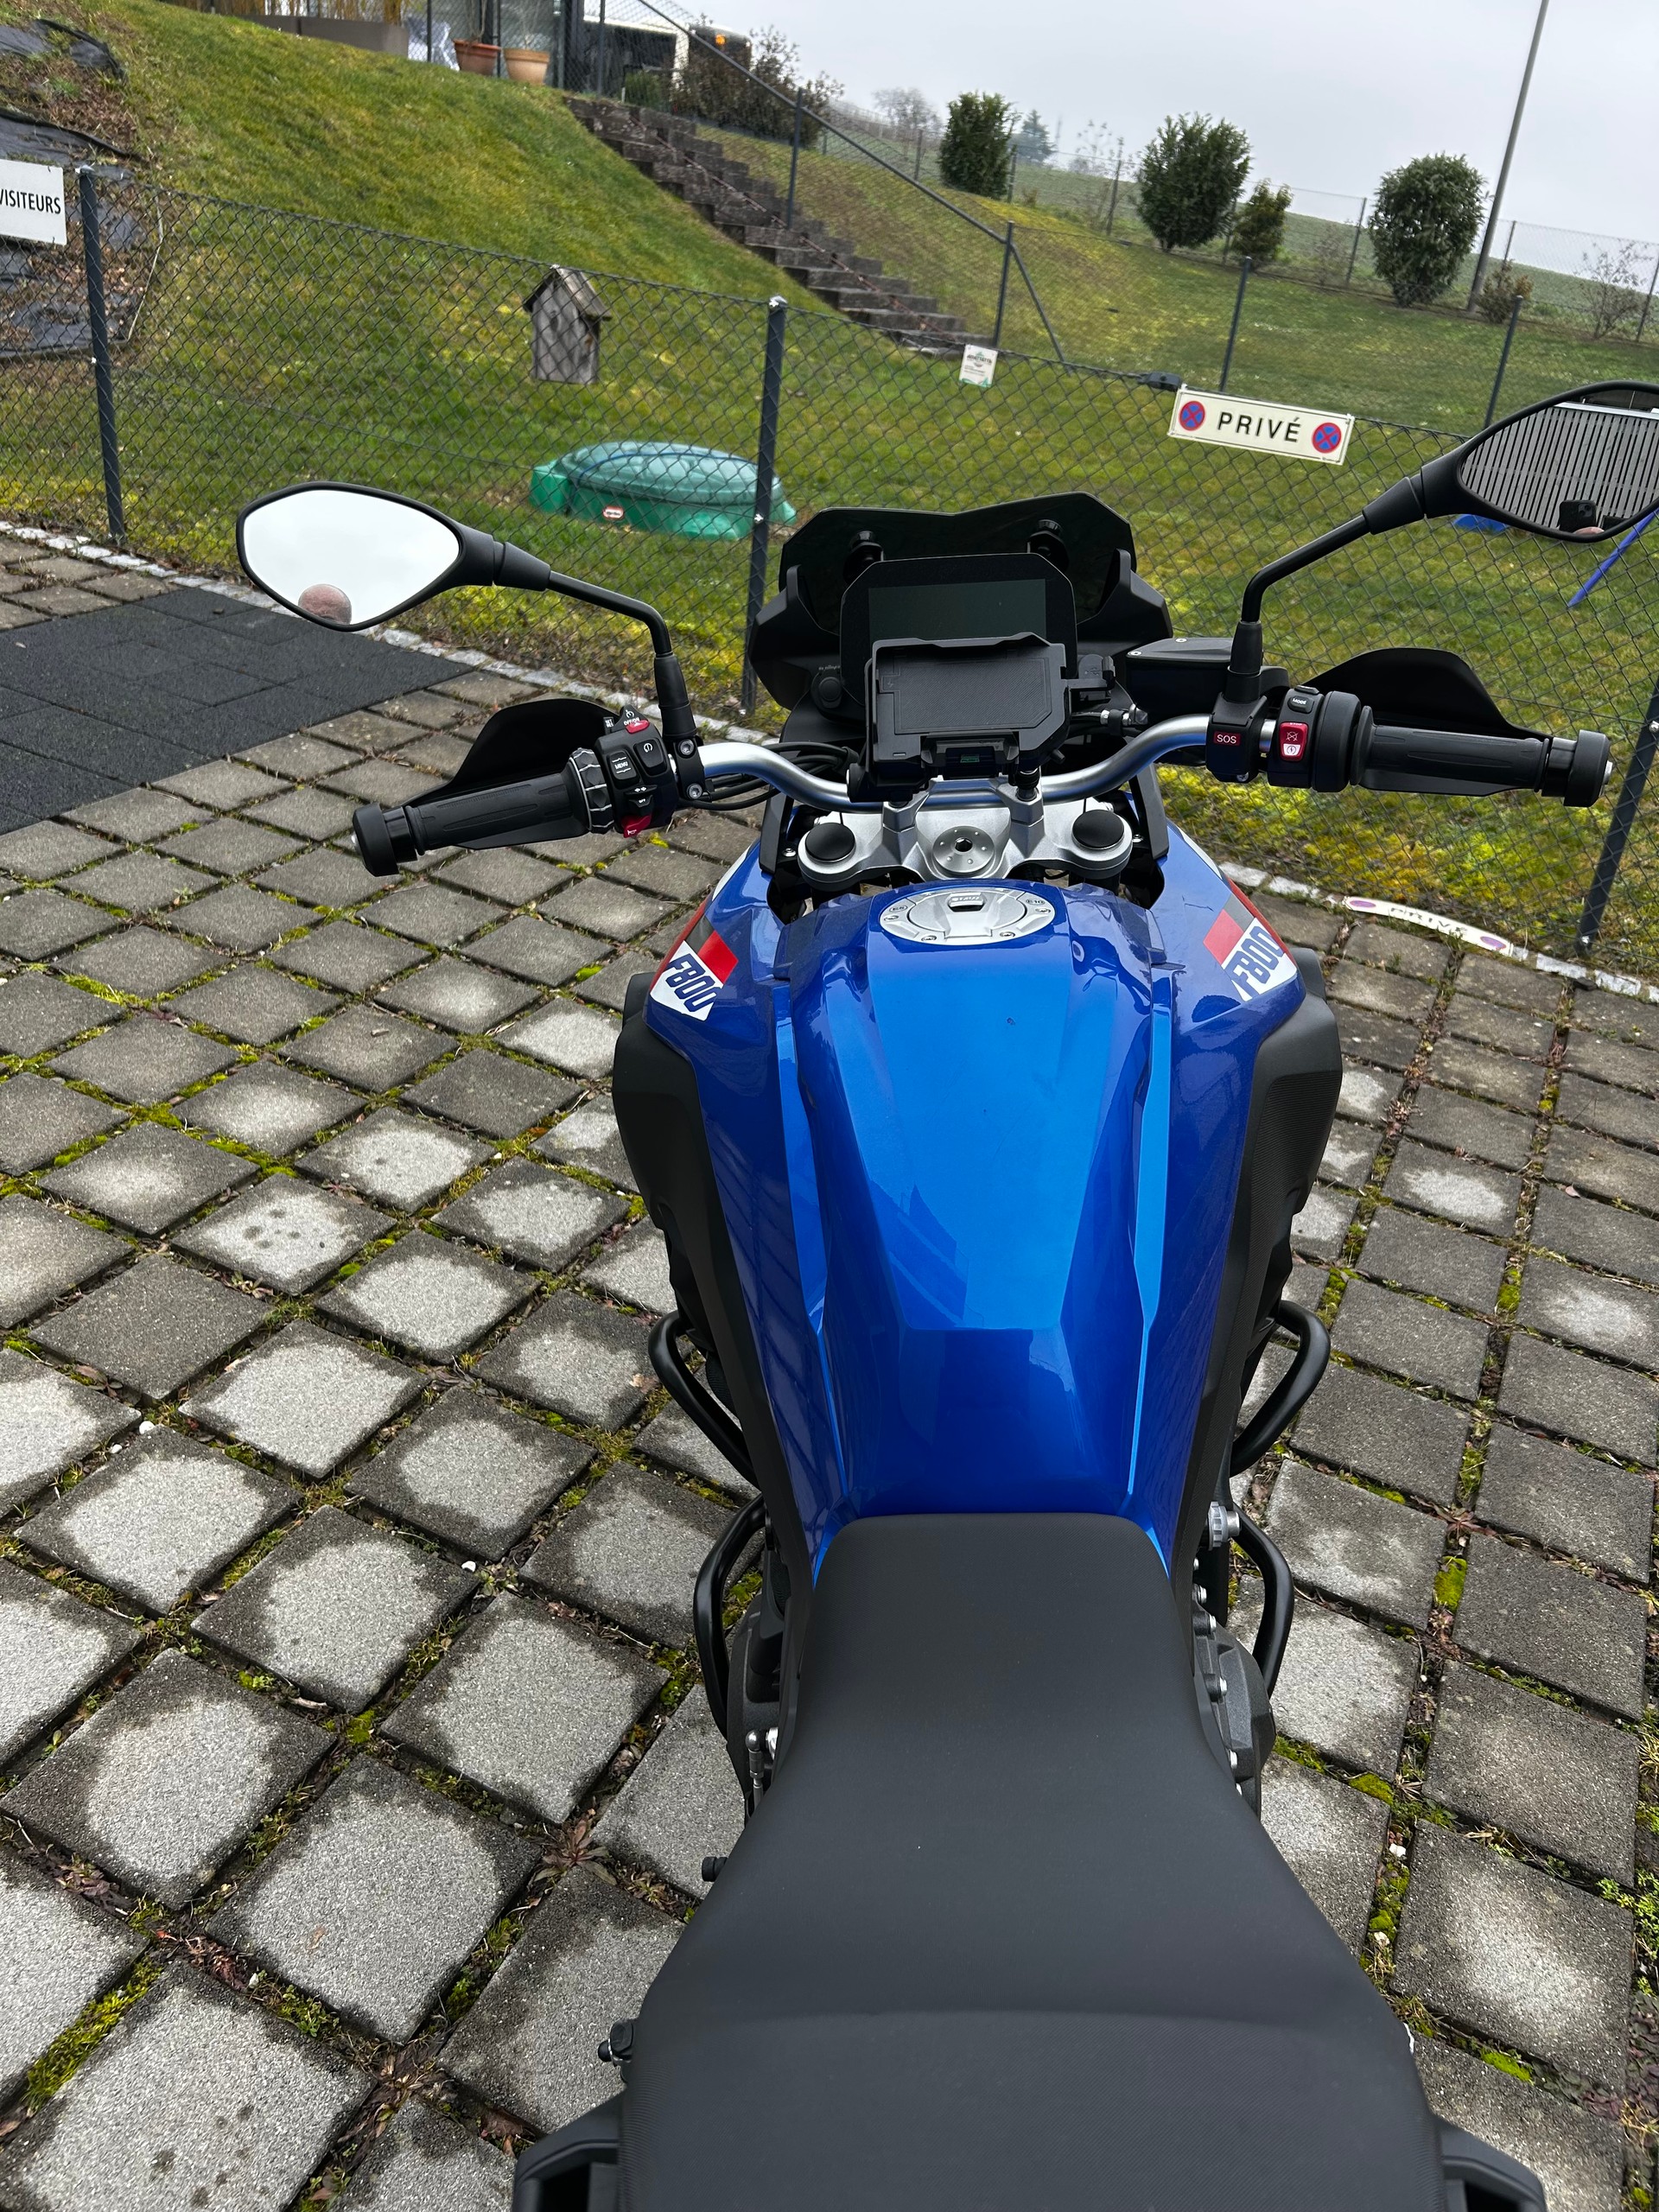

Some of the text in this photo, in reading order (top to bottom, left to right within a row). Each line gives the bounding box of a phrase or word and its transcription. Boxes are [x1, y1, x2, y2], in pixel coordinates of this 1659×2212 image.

[1217, 411, 1301, 443] PRIVÉ
[1217, 734, 1237, 744] SOS
[662, 953, 717, 1013] F800
[1224, 925, 1284, 999] F800
